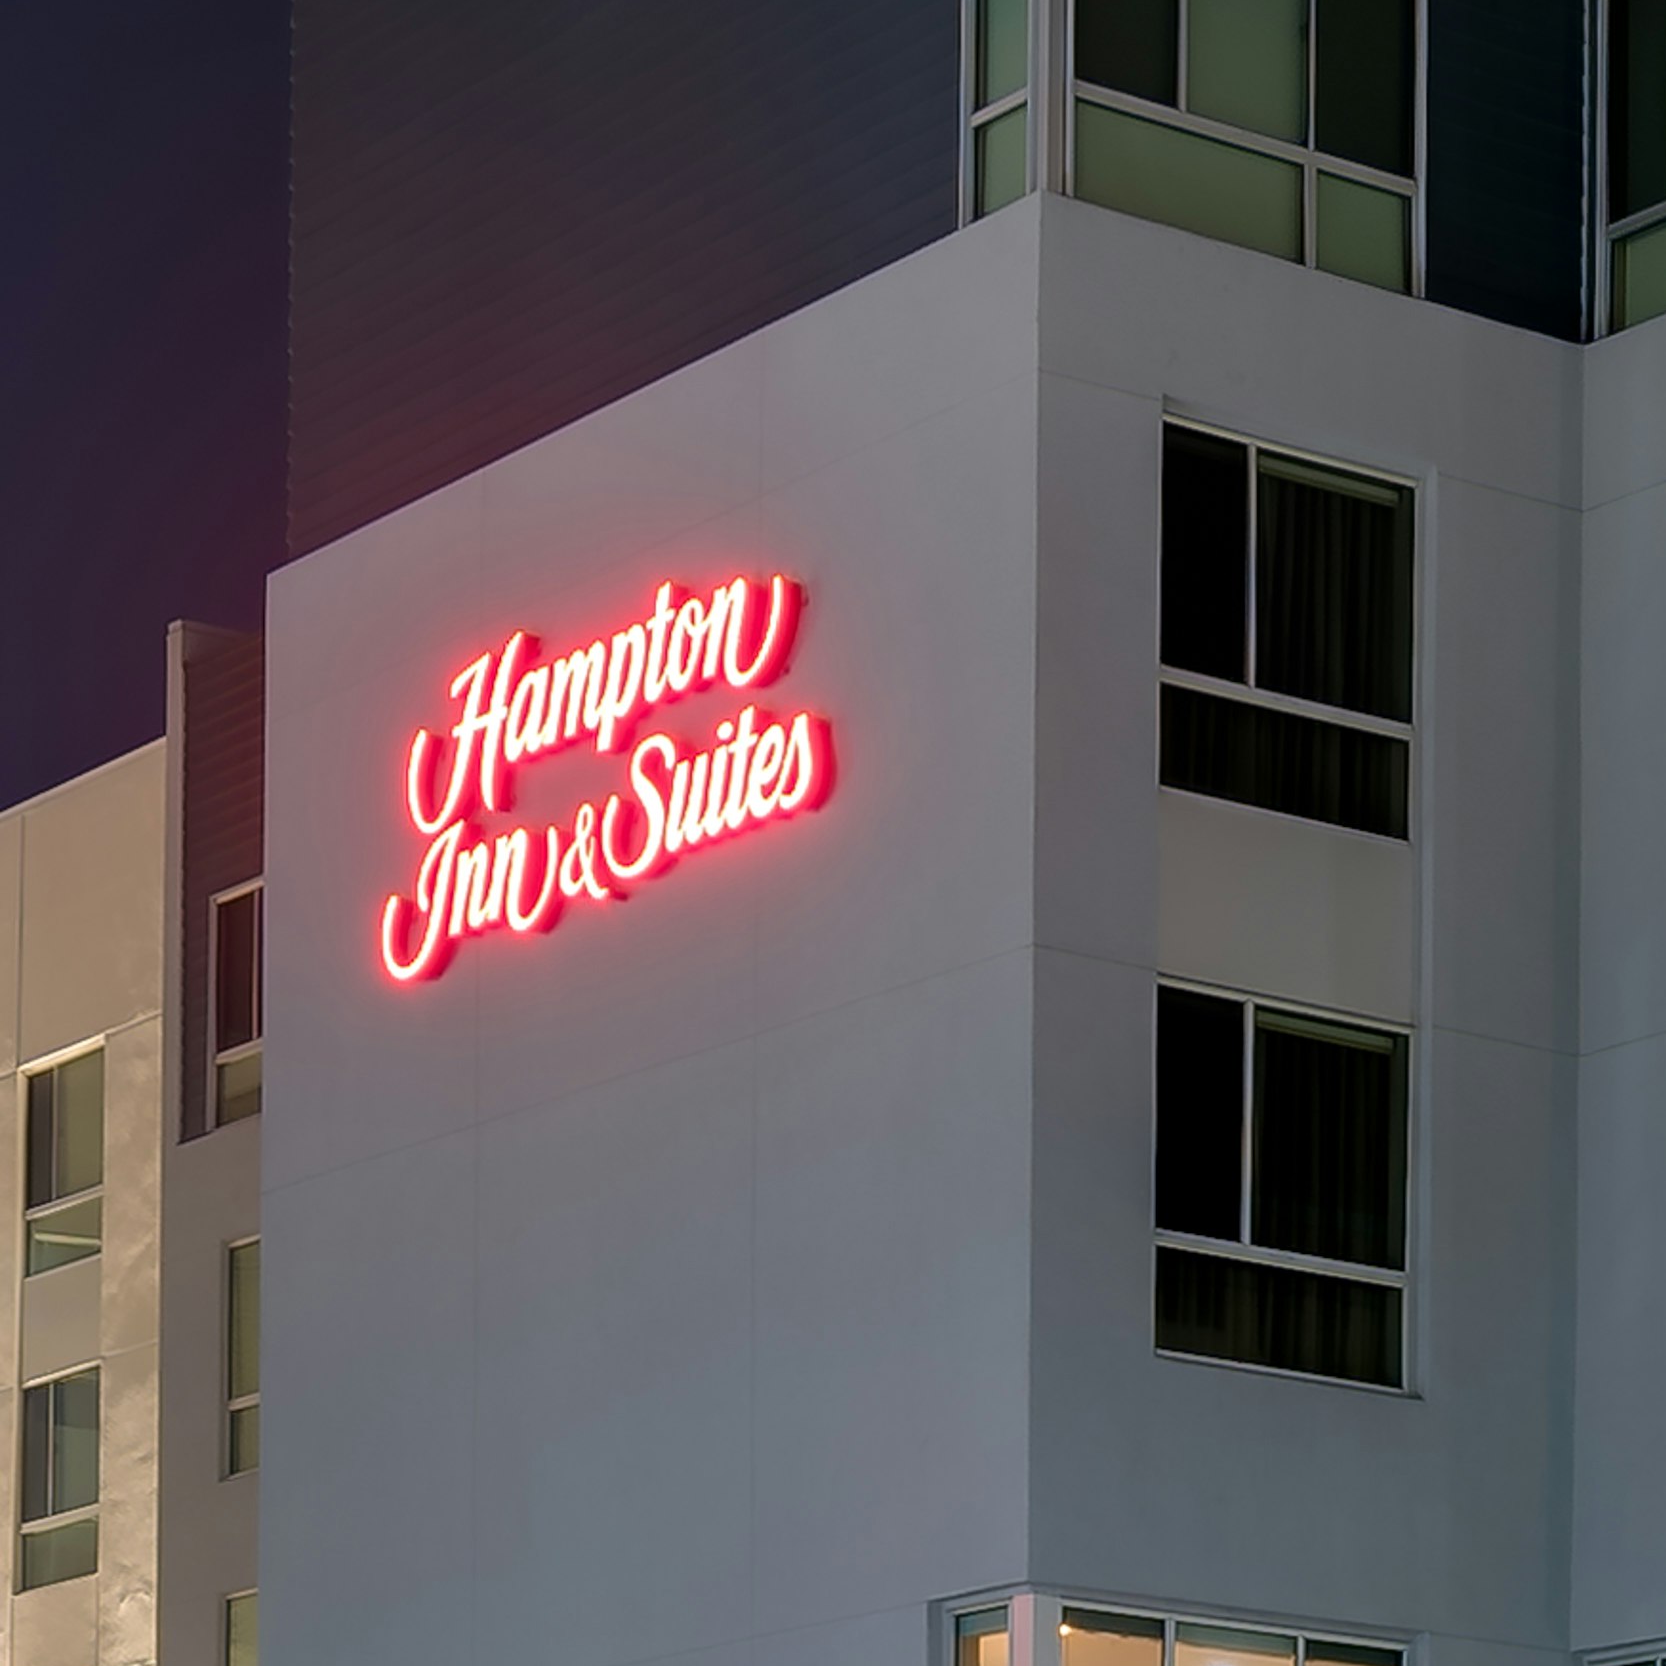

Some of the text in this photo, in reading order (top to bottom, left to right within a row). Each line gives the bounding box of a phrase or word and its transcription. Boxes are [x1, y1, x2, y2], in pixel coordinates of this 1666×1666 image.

[408, 573, 797, 834] Hampton
[382, 704, 824, 980] Inn & Suites
